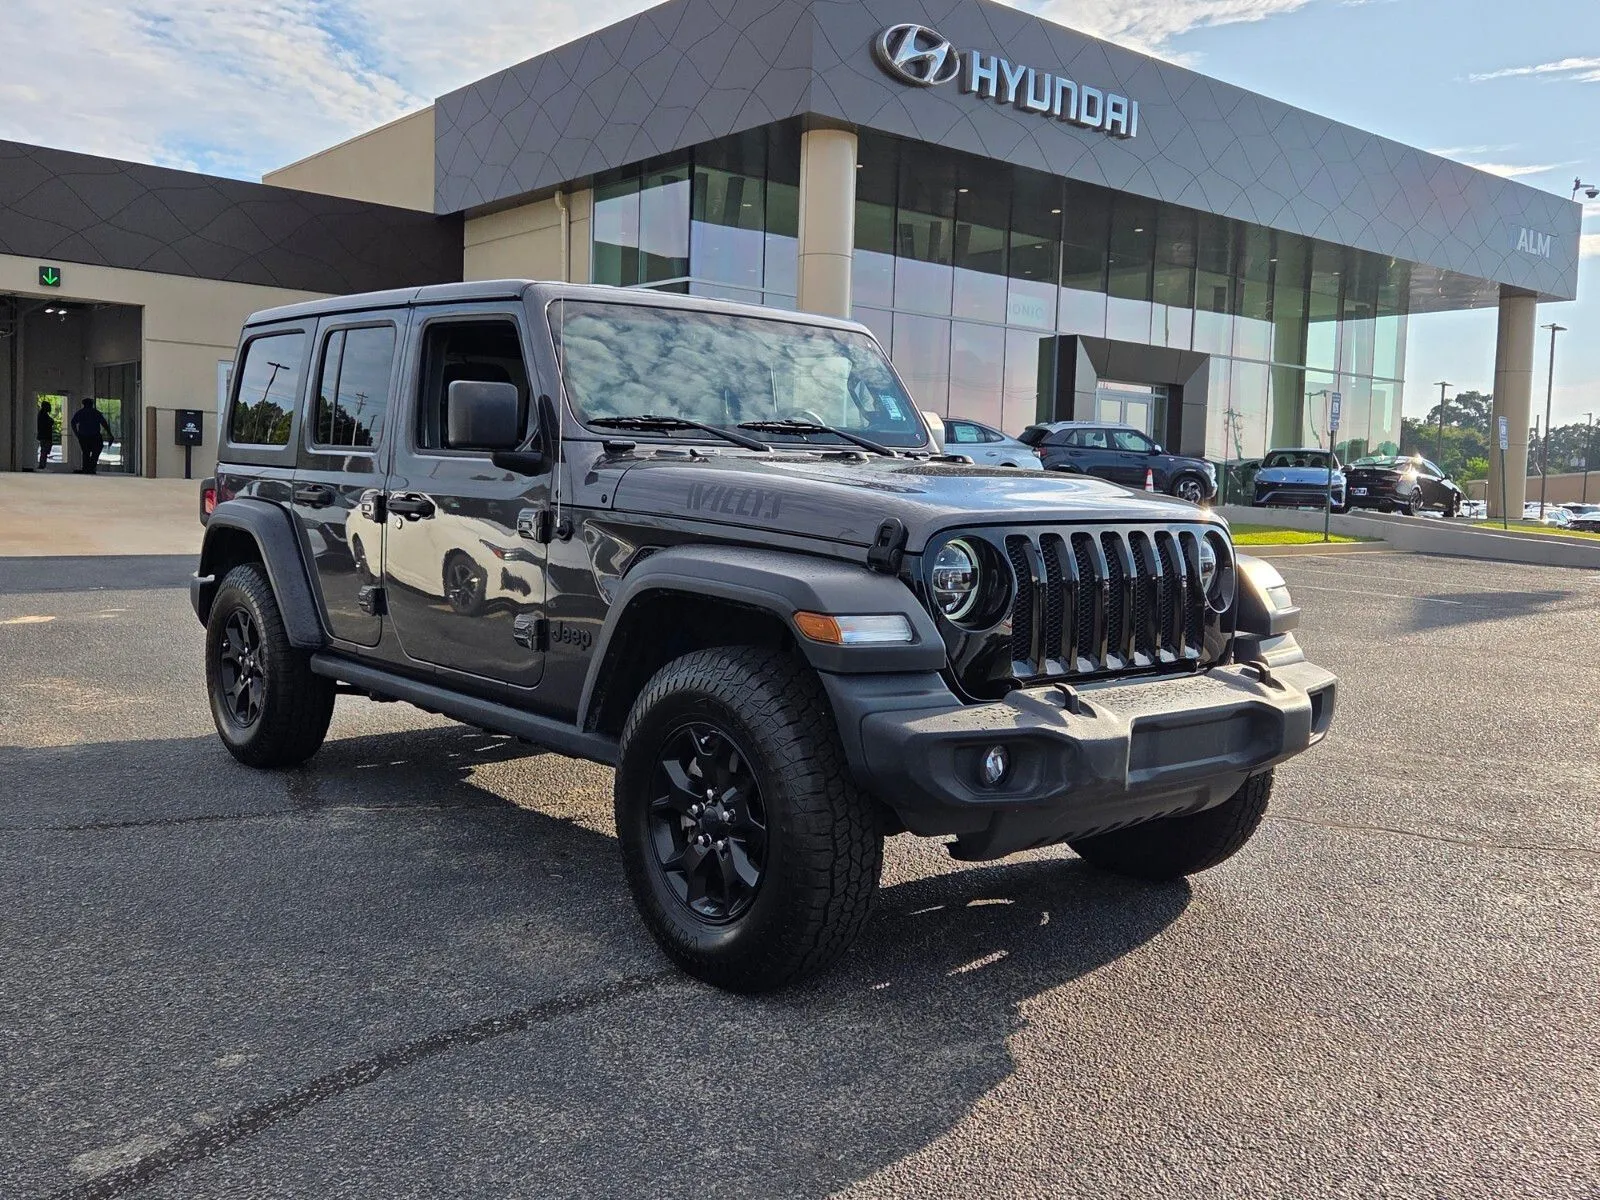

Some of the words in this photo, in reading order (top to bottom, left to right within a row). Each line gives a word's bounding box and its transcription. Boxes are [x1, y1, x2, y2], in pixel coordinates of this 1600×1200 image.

[969, 50, 1139, 138] HYUNDAI
[1516, 227, 1551, 258] ALM
[551, 620, 592, 651] Jeep
